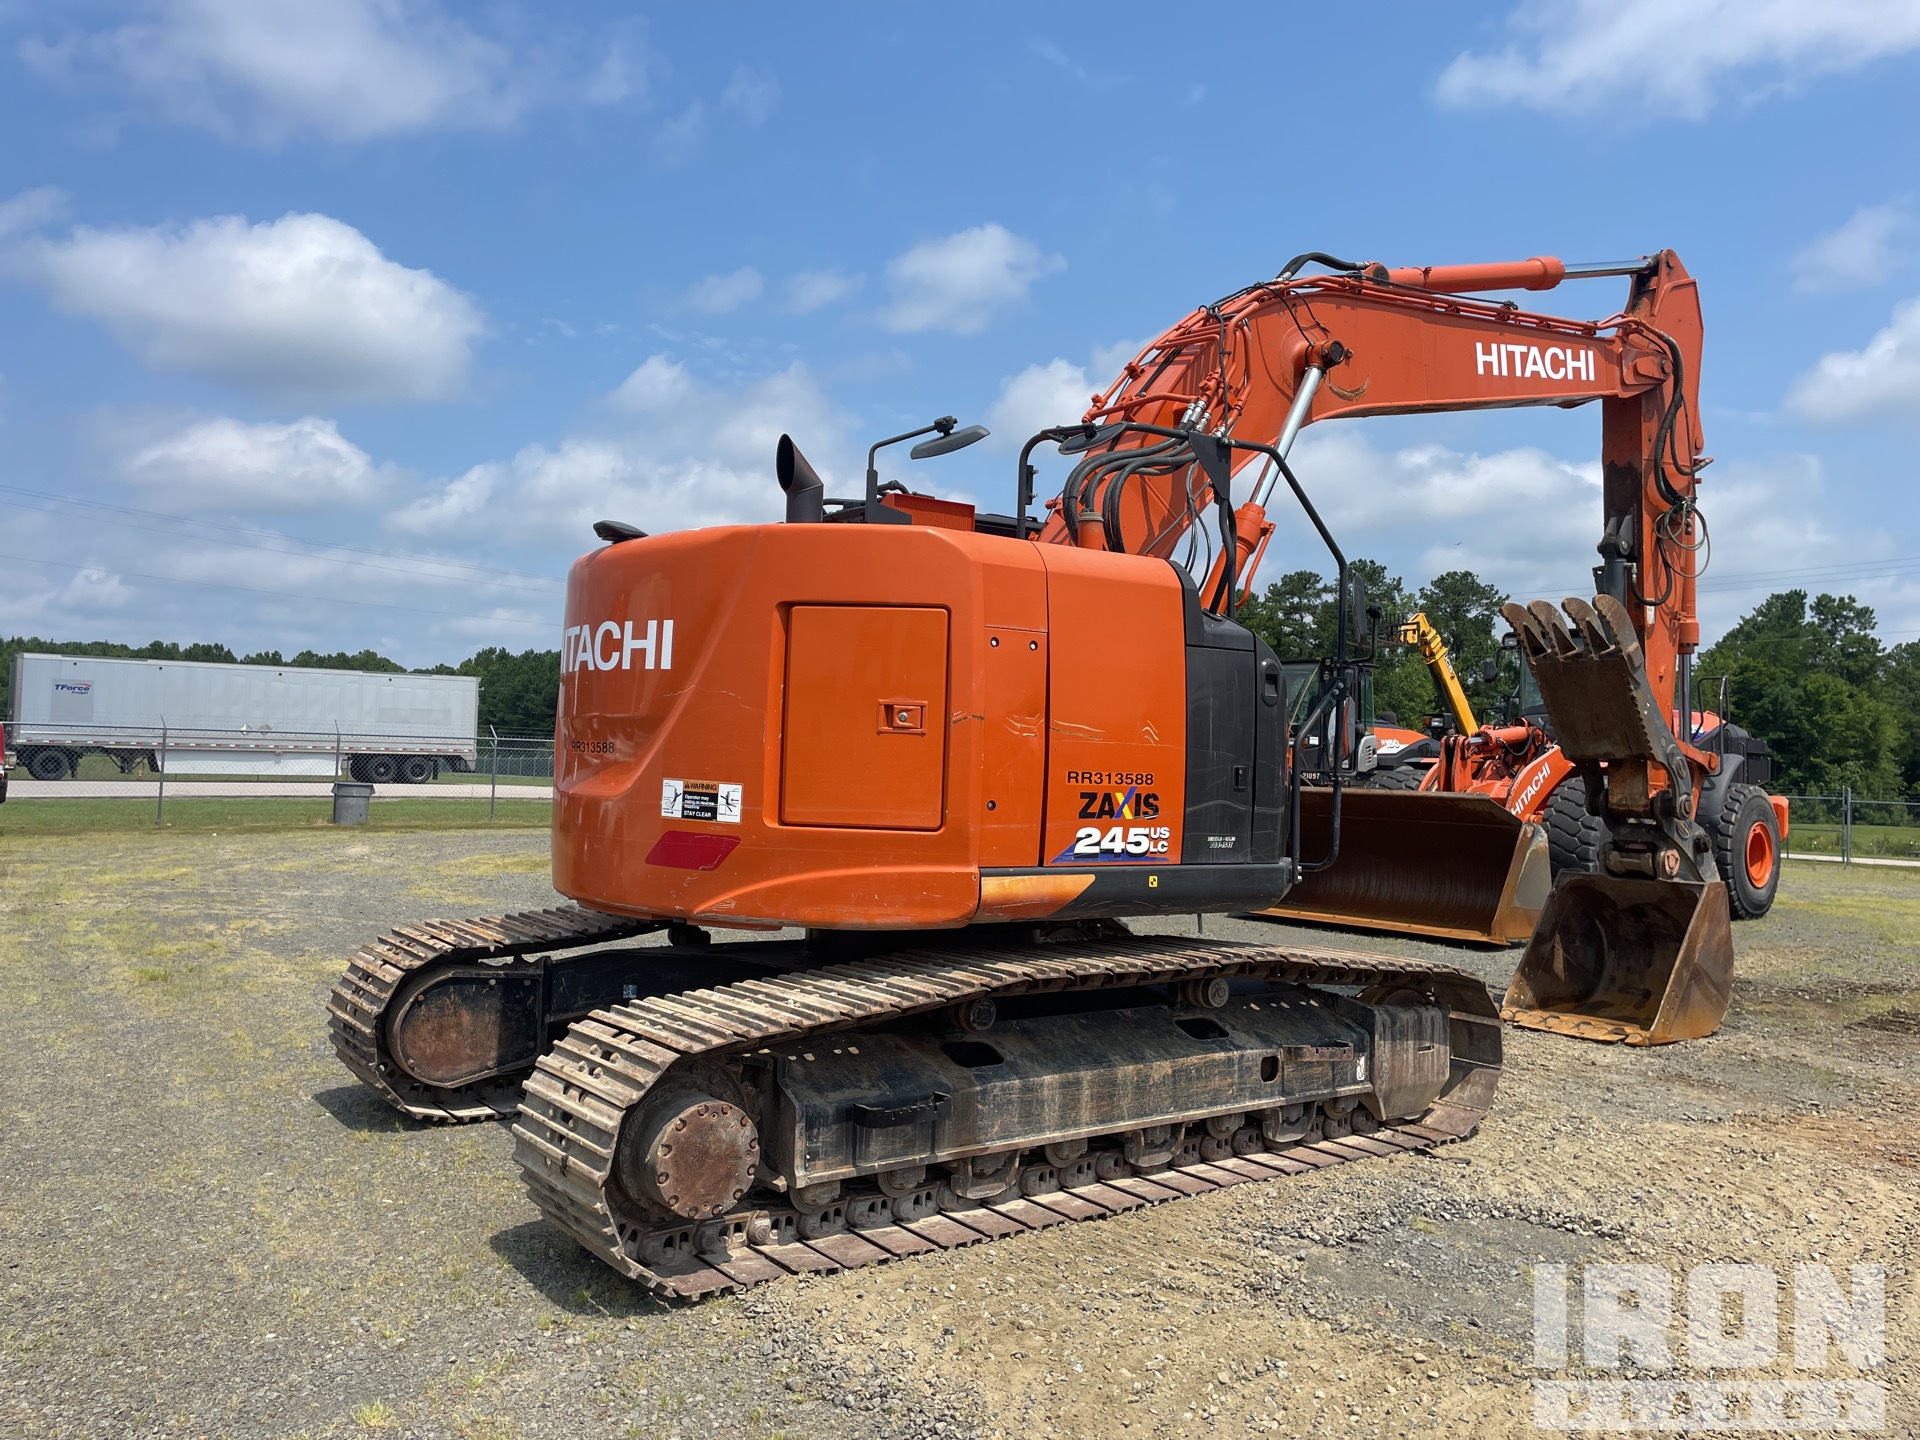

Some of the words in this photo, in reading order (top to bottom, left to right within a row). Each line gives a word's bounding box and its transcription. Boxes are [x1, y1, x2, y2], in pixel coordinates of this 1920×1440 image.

[1475, 341, 1596, 381] HITACHI
[54, 683, 91, 692] TForce
[572, 741, 615, 753] RR313588
[1067, 770, 1154, 786] RR313588
[1302, 771, 1321, 780] 21097
[1510, 761, 1551, 816] HITACHI
[1078, 786, 1160, 819] ZAXIS
[1073, 827, 1150, 855] 245
[1149, 827, 1171, 839] US
[1149, 841, 1169, 854] LC
